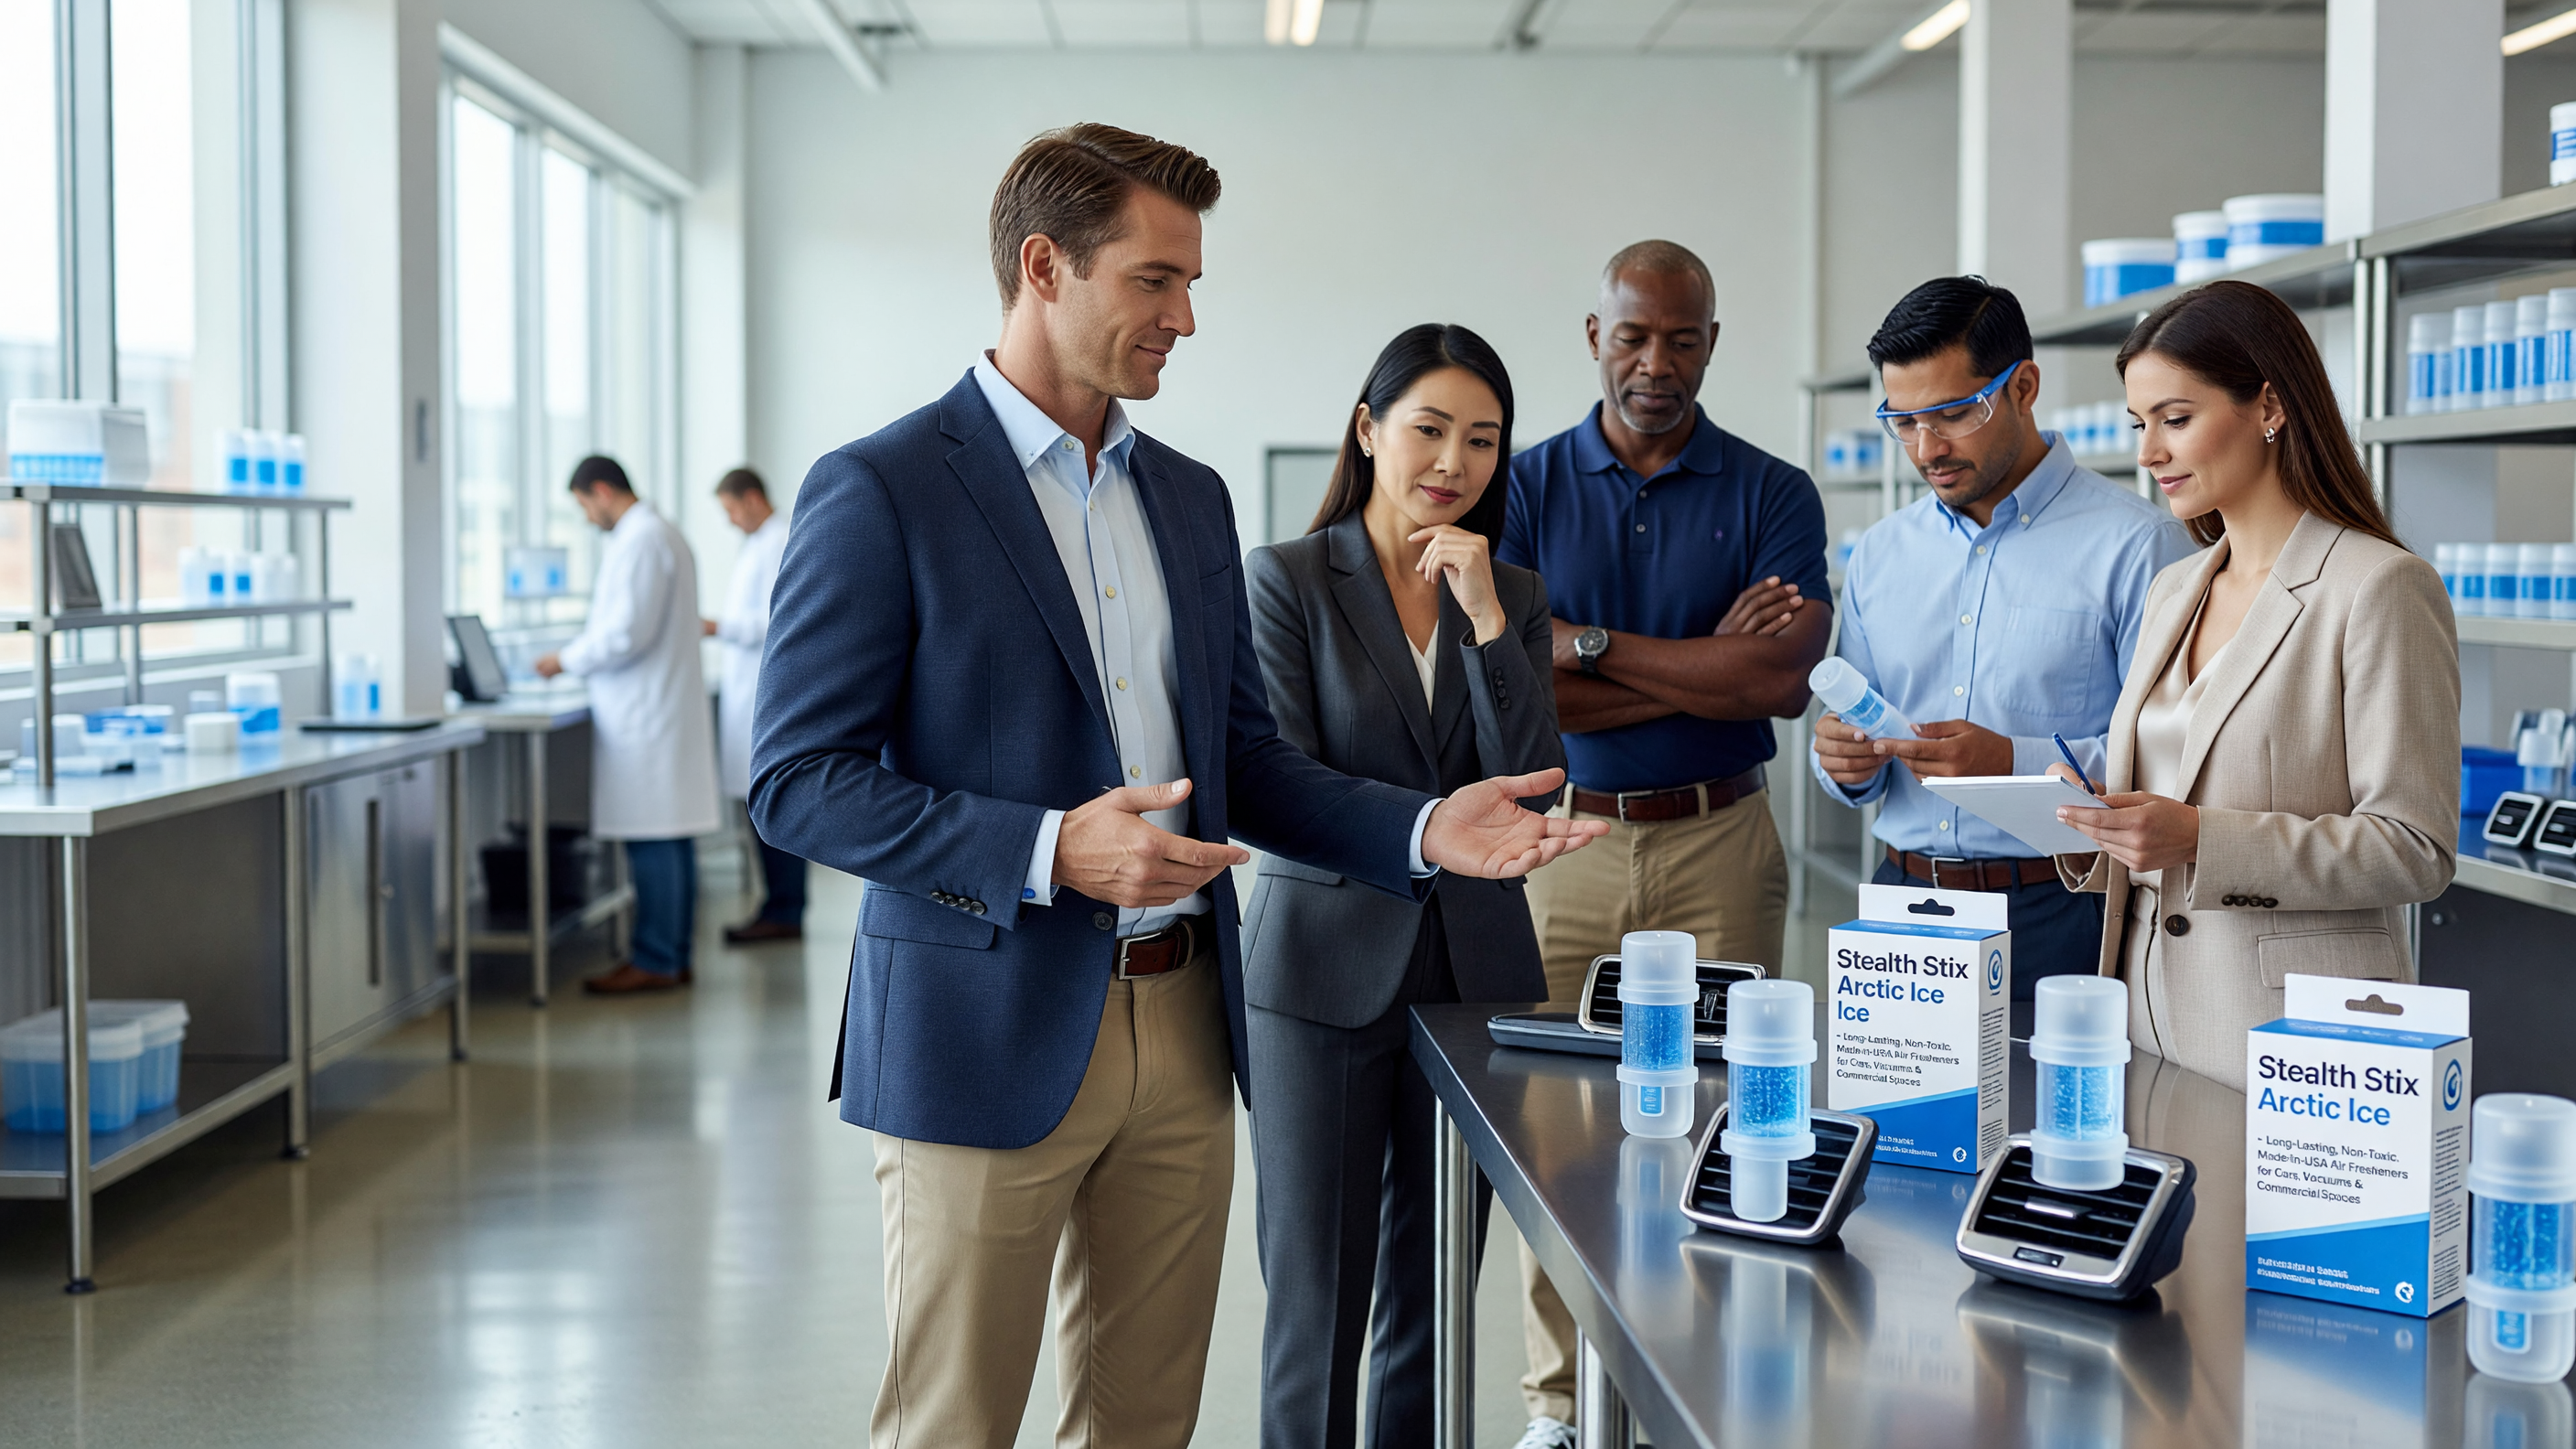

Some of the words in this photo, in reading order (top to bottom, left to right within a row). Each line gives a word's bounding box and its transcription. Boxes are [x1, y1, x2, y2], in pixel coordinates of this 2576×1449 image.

[1837, 949, 1917, 974] Stealth
[1923, 955, 1969, 979] Stix
[1837, 975, 1905, 1001] Arctic
[1911, 982, 1945, 1004] Ice
[1838, 1001, 1870, 1022] Ice
[2258, 1056, 2356, 1089] Stealth
[2364, 1068, 2420, 1097] Stix
[2258, 1088, 2341, 1120] Arctic
[2349, 1098, 2390, 1126] Ice
[2257, 1165, 2271, 1176] for
[2330, 1160, 2345, 1171] Air
